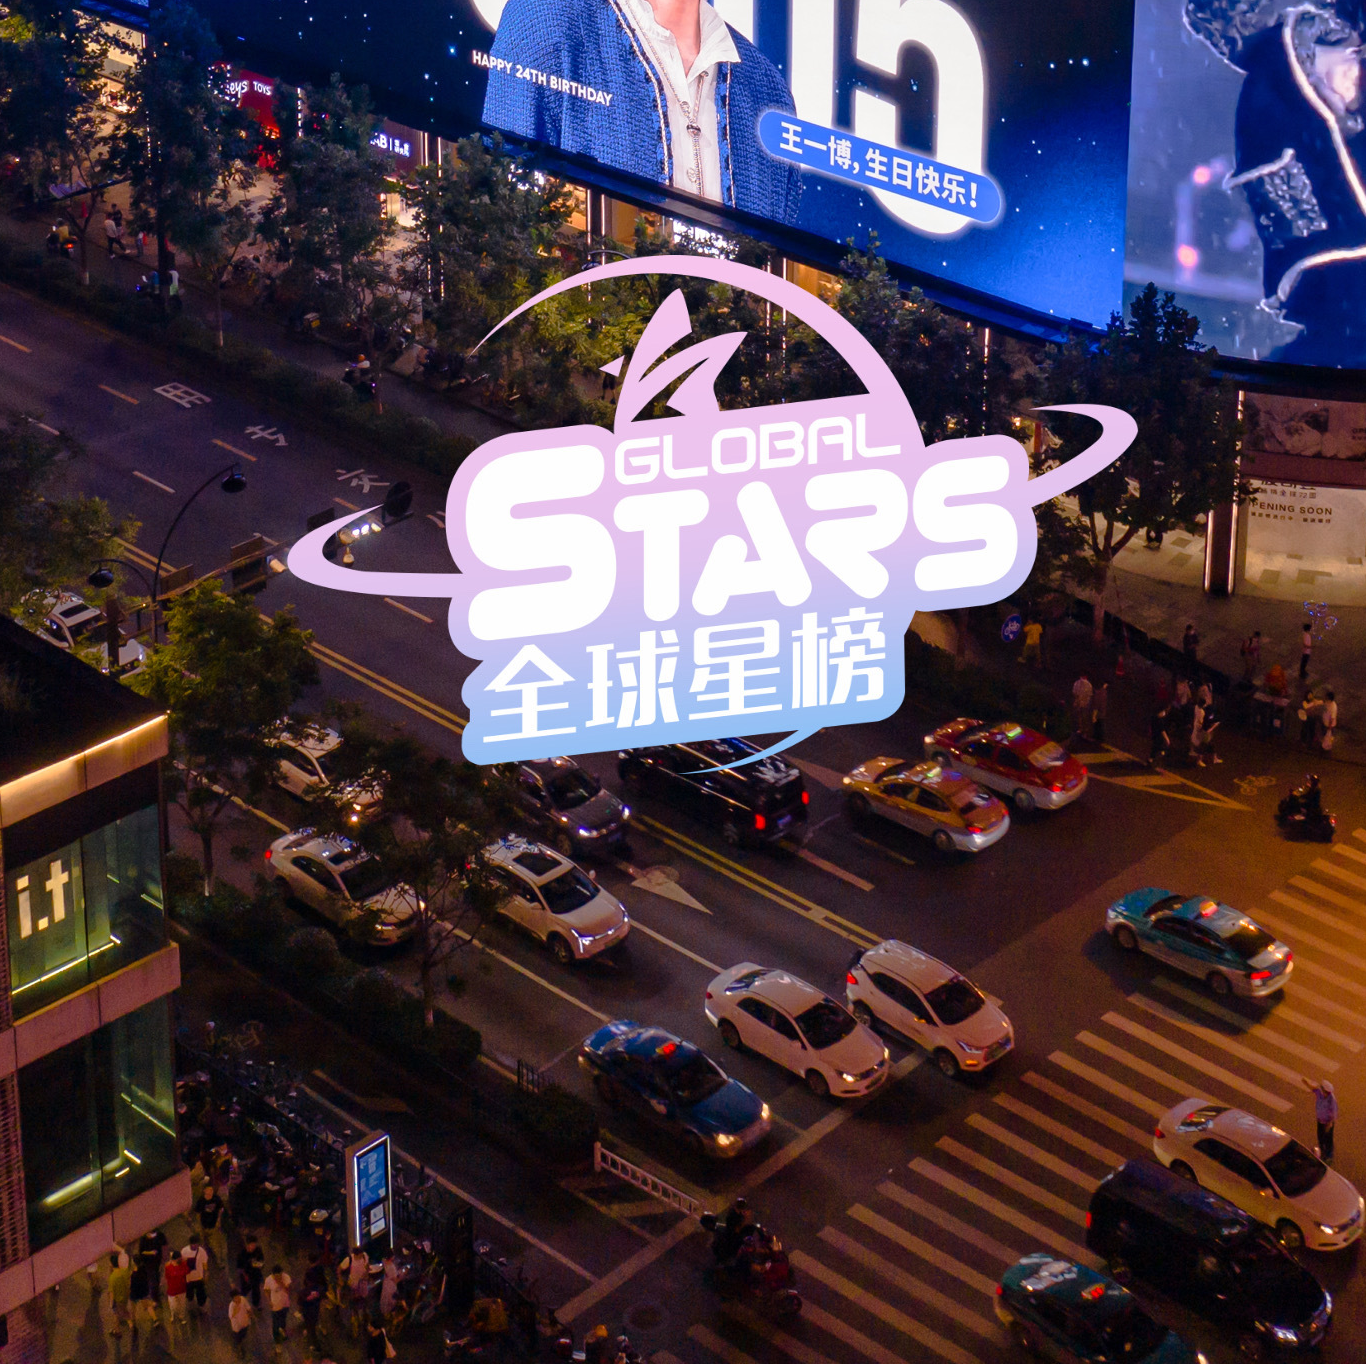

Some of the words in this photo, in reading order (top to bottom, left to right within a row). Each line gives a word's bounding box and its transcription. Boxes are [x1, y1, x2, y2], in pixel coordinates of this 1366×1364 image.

[252, 81, 273, 96] TOYS
[471, 50, 513, 78] HAPPY
[514, 63, 549, 87] 24TH
[549, 72, 614, 107] BIRTHDAY
[1248, 499, 1295, 513] PENING
[1299, 506, 1333, 516] SOON
[15, 858, 71, 939] i.t
